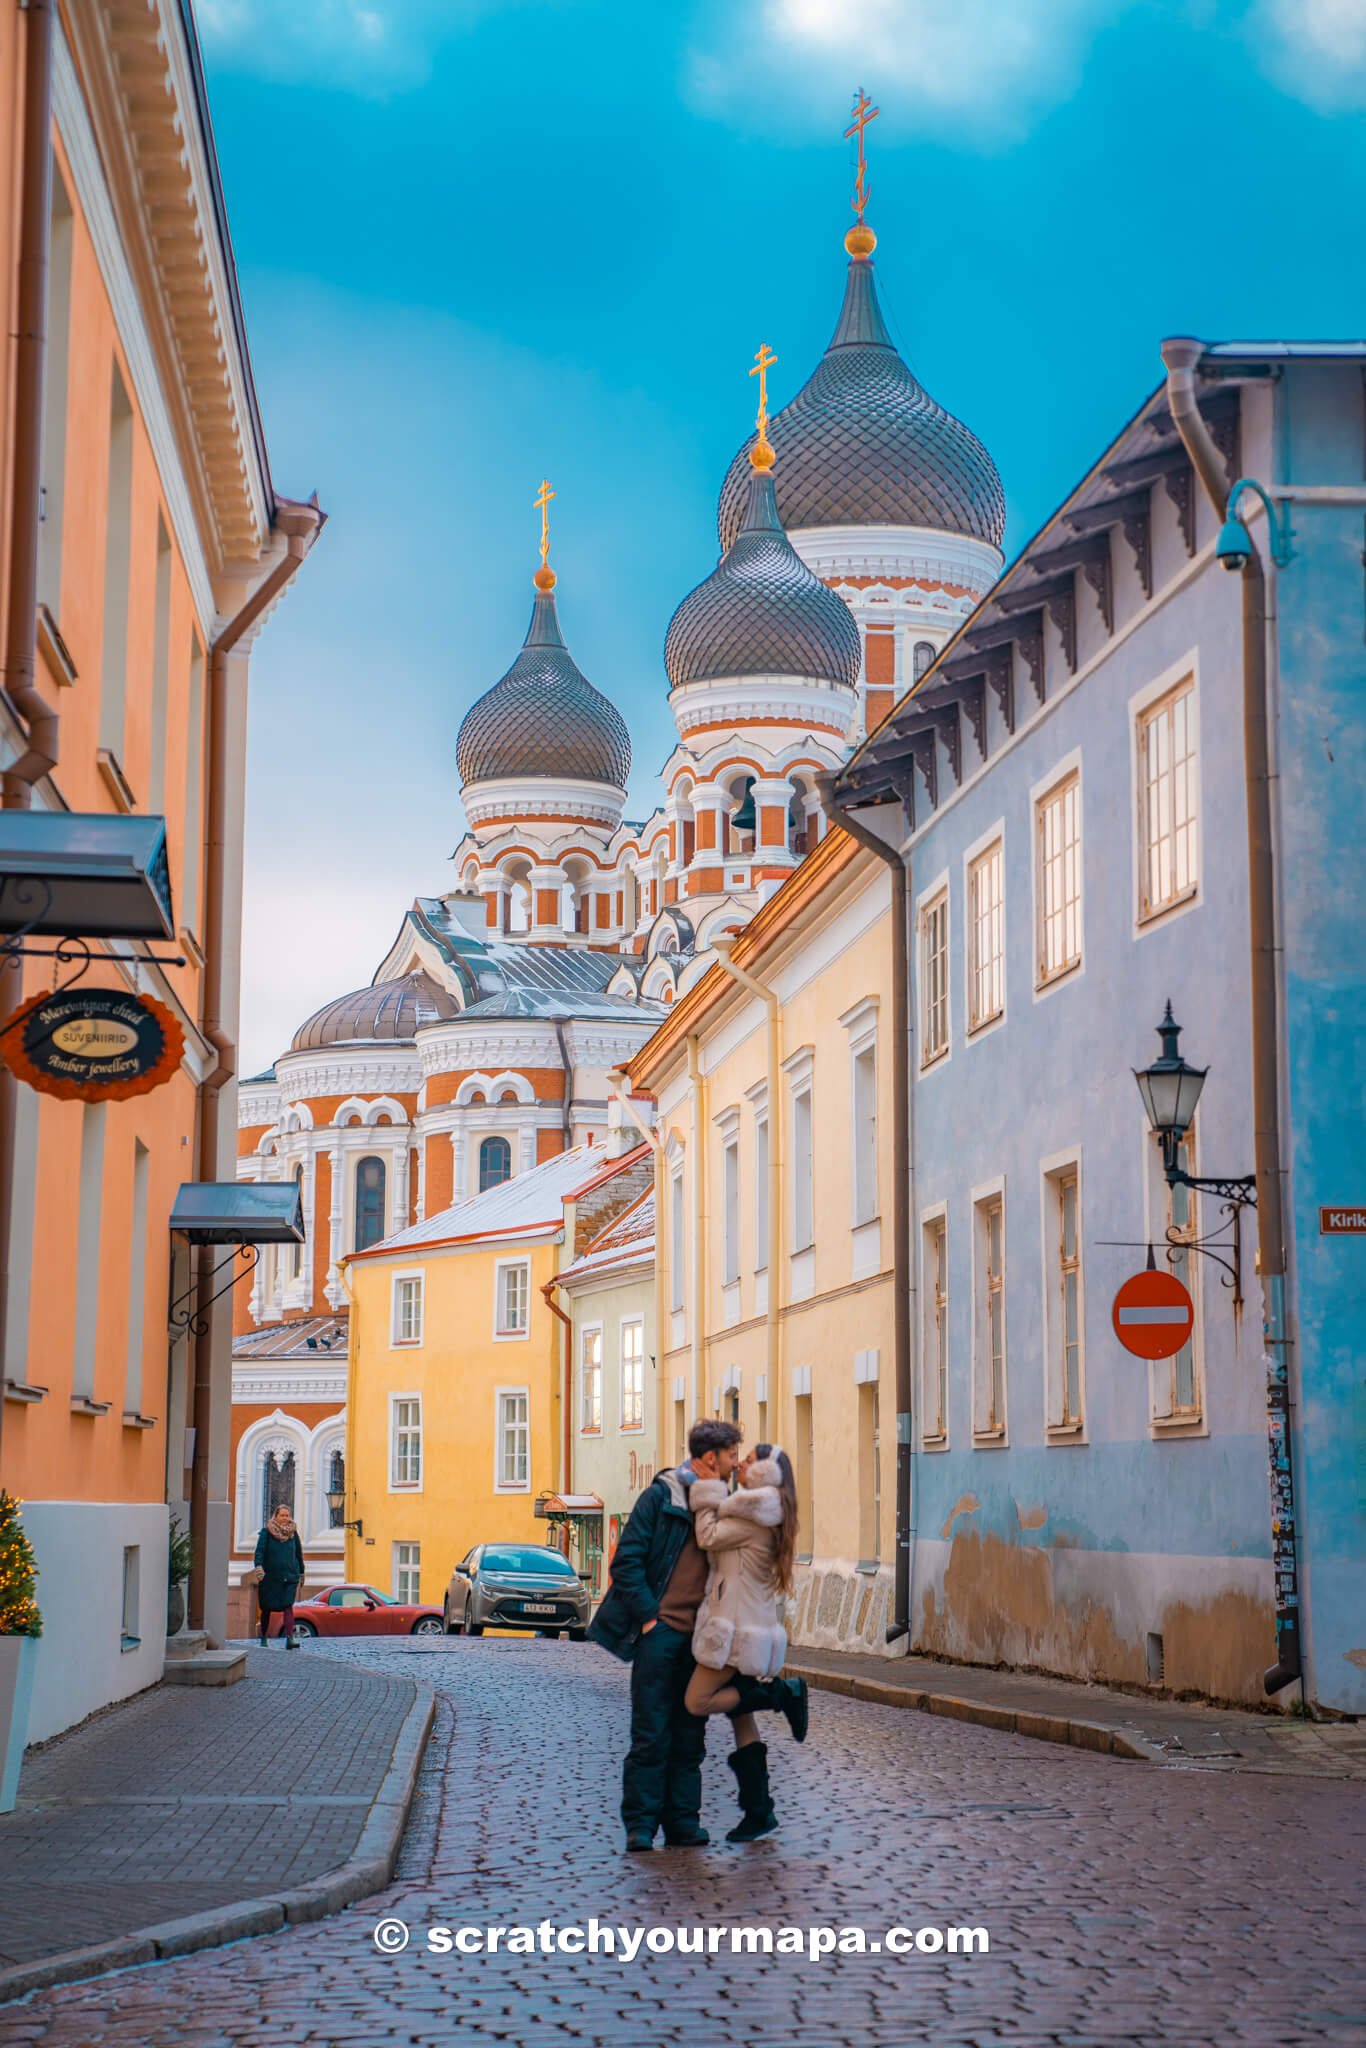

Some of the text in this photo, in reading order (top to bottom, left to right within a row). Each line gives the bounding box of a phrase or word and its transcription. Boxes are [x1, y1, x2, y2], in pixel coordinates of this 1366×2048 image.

[62, 1032, 128, 1044] SUVENIIRID
[48, 1054, 139, 1079] Amber jewellery
[1329, 1213, 1366, 1227] Kirik
